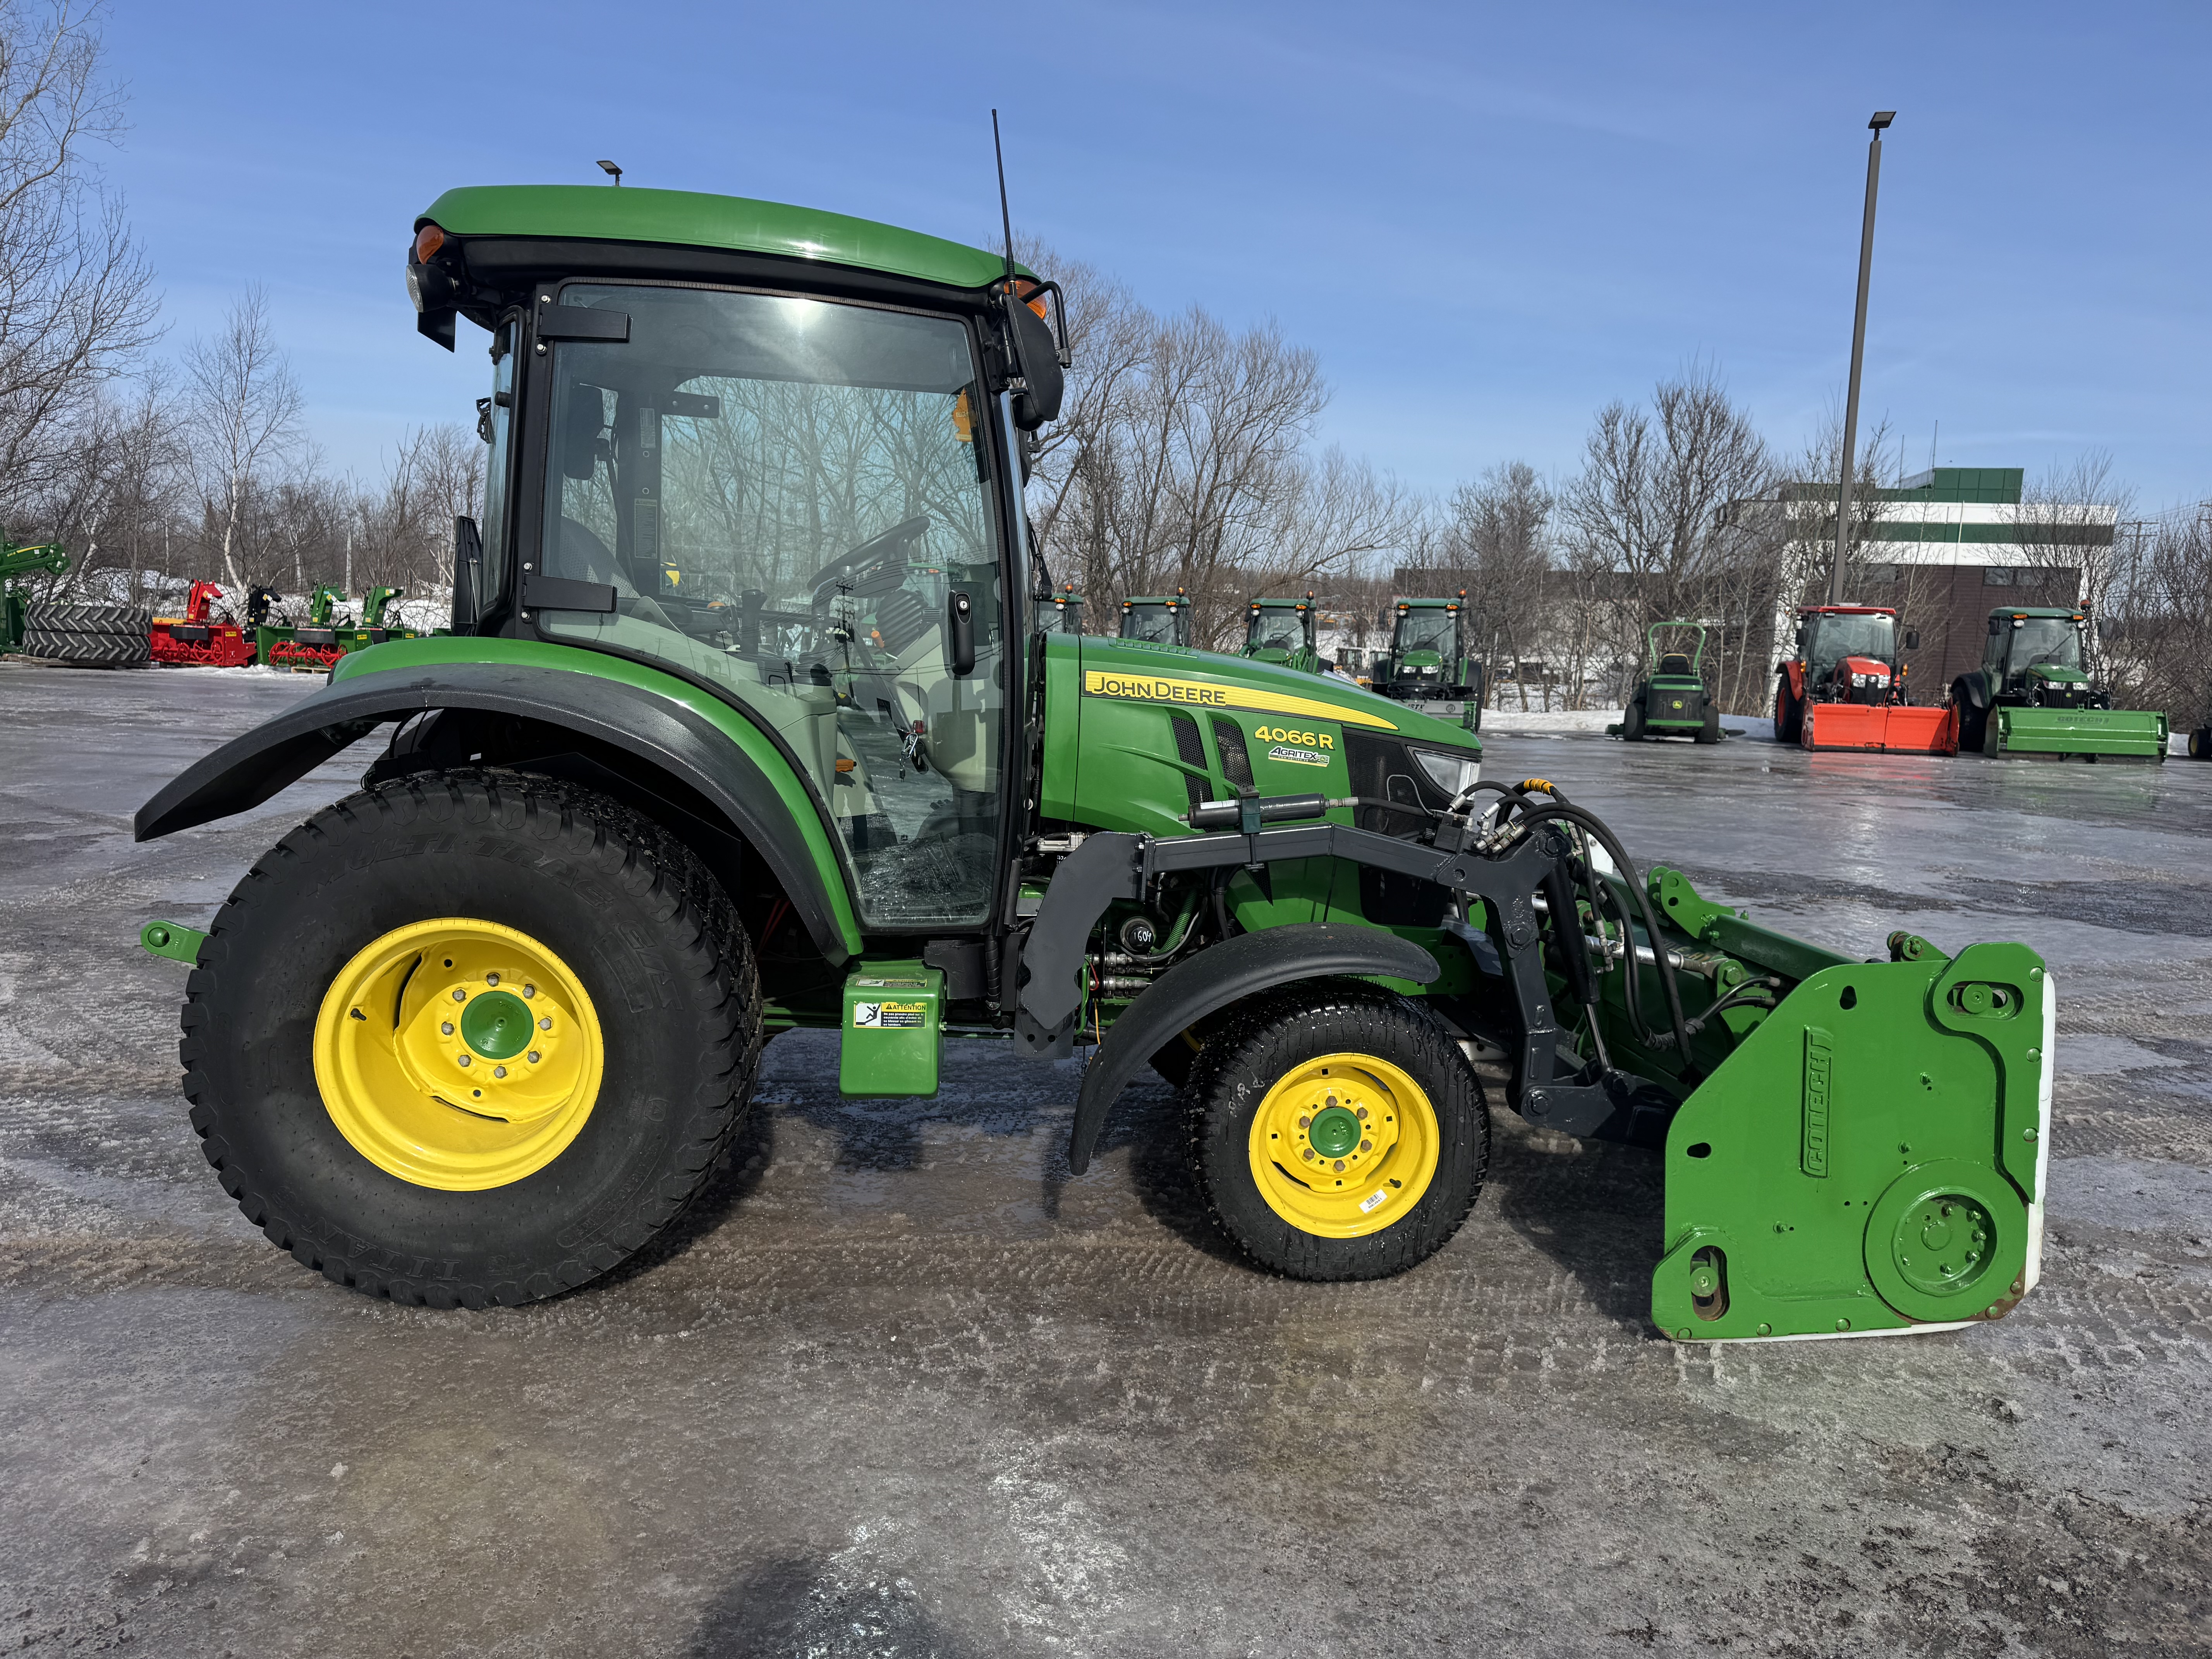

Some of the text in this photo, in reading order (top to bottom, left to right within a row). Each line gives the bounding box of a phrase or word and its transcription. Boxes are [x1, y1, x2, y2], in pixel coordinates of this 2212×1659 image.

[1094, 677, 1226, 704] JOHN DEERE
[1271, 747, 1317, 761] AGRITEX
[1134, 930, 1152, 942] 1604
[302, 1216, 465, 1282] TITAN
